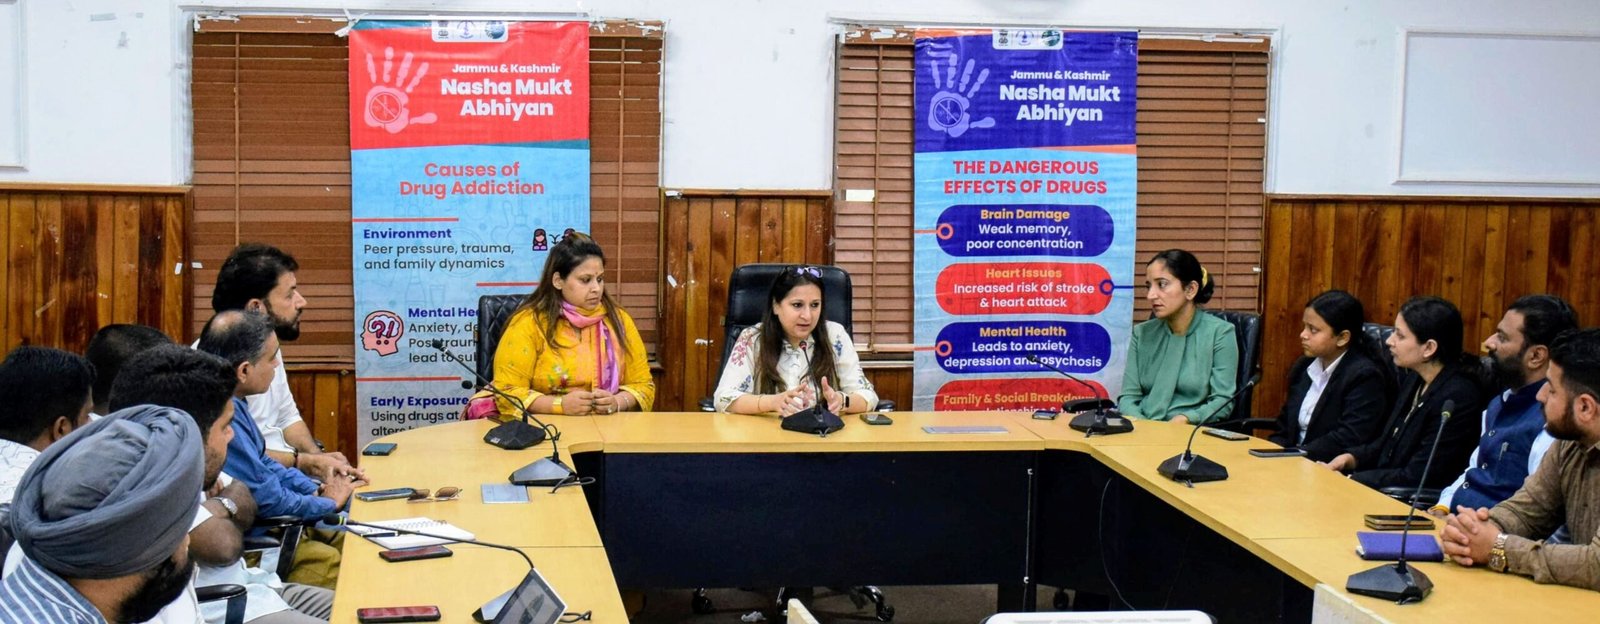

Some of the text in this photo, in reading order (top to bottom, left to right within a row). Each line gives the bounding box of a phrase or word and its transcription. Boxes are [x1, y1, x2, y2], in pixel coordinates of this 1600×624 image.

[452, 63, 561, 74] Jammu & Kashmir
[1010, 70, 1110, 80] Jammu & Kashmir
[440, 78, 572, 96] Nasha Mukt
[1000, 84, 1120, 102] Nasha Mukt
[460, 98, 554, 122] Abhiyan
[1016, 104, 1103, 126] Abhiyan
[424, 162, 520, 178] Causes of
[953, 160, 1099, 174] THE DANGEROUS
[400, 180, 544, 200] Drug Addiction
[944, 180, 1107, 194] EFFECTS OF DRUGS
[980, 209, 1070, 222] Brain Damage
[364, 228, 452, 239] Environment
[978, 224, 1072, 237] Weak memory,
[364, 243, 515, 256] Peer pressure, trauma,
[966, 238, 1084, 252] poor concentration
[364, 258, 505, 272] and family dynamics
[986, 268, 1062, 278] Heart Issues
[954, 282, 1094, 294] Increased risk of stroke
[980, 297, 1067, 308] & heart attack
[408, 308, 455, 318] Mental
[409, 322, 460, 335] Anxiety,
[980, 326, 1066, 337] Mental Health
[972, 340, 1073, 354] Leads to anxiety,
[409, 352, 438, 362] lead
[441, 353, 454, 362] to
[944, 355, 1011, 368] depression
[1040, 356, 1102, 368] psychosis
[370, 396, 469, 410] Early Exposure
[944, 393, 979, 406] Family
[984, 394, 992, 404] &
[994, 392, 1028, 403] Social
[371, 410, 460, 424] Using drugs at
